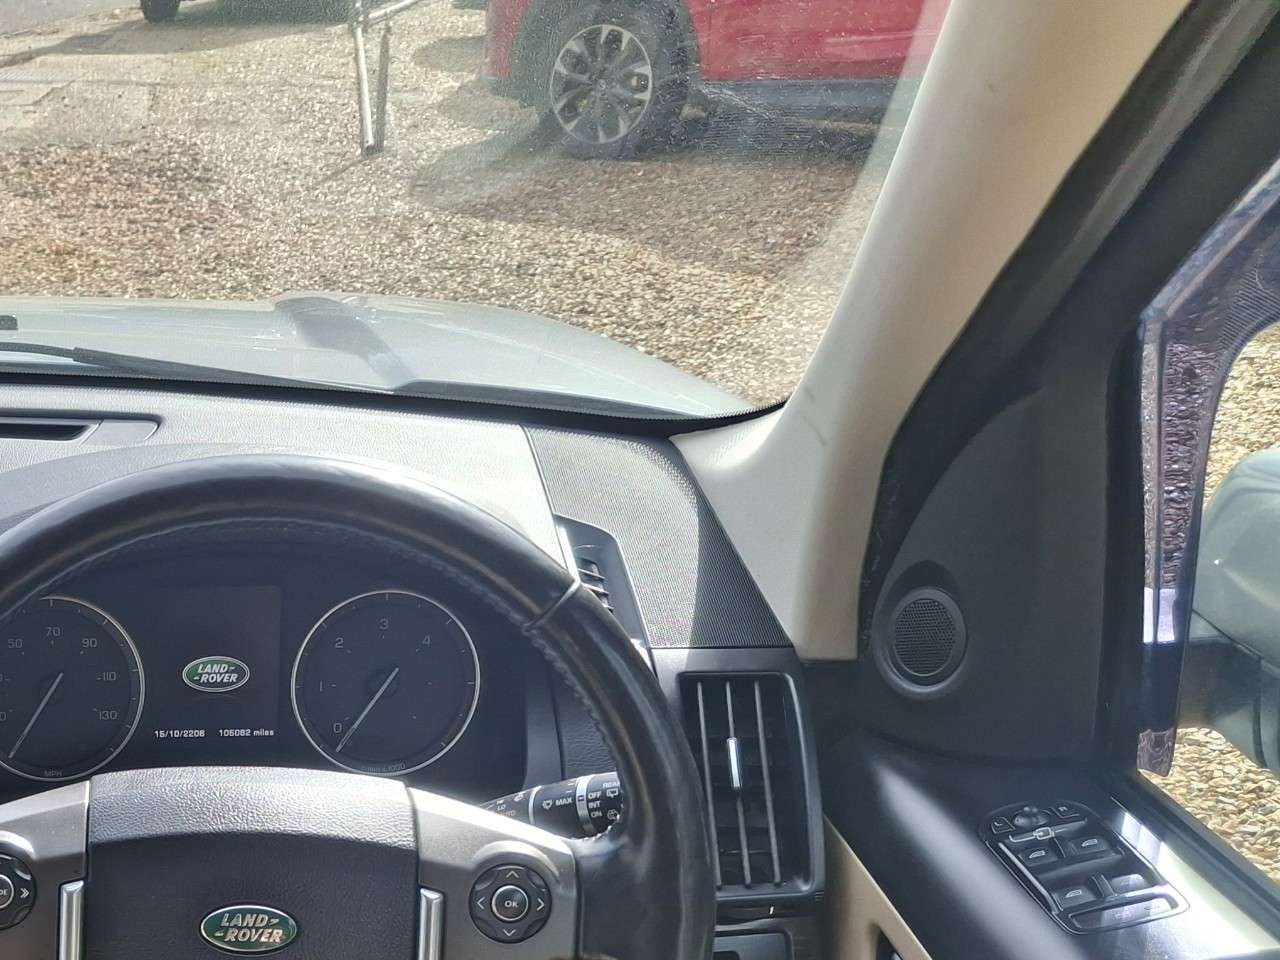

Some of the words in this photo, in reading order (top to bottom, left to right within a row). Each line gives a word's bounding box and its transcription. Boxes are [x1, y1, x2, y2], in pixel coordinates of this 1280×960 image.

[379, 618, 389, 630] 3
[45, 626, 61, 637] 70
[7, 638, 23, 649] 50
[81, 638, 98, 648] 90
[335, 637, 344, 648] 2
[422, 635, 431, 646] 4
[197, 663, 229, 674] LAND
[102, 671, 117, 682] 110
[199, 673, 239, 683] ROVER
[99, 710, 118, 721] 130
[253, 728, 275, 736] miles
[333, 722, 343, 733] 0
[43, 769, 63, 777] MPH
[587, 791, 602, 800] OFF
[555, 797, 573, 806] MAX
[588, 800, 601, 809] INT
[504, 900, 518, 908] OK
[220, 912, 269, 927] LAND
[223, 927, 284, 943] ROVER
